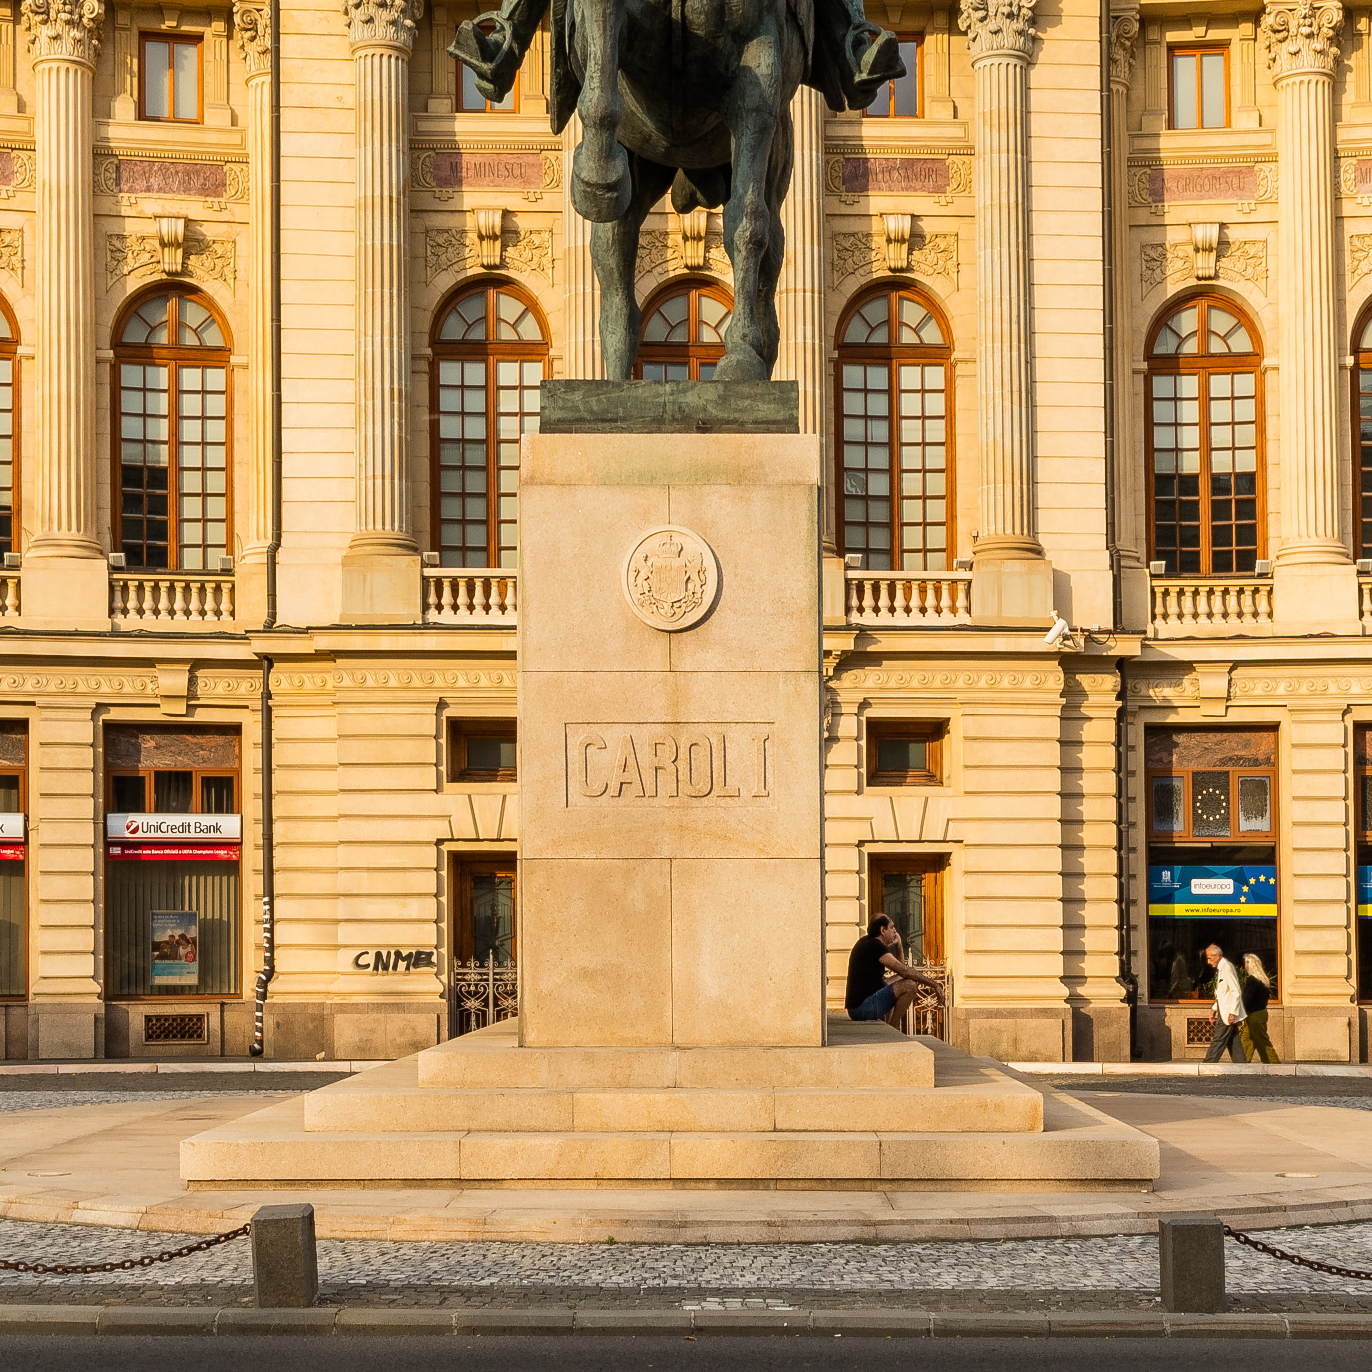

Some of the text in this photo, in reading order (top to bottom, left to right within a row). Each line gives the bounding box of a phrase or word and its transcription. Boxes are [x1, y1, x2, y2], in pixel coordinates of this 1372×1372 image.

[578, 734, 770, 798] CAROL I
[141, 821, 222, 834] UniCredit Bank
[1193, 881, 1231, 891] infoeuropa
